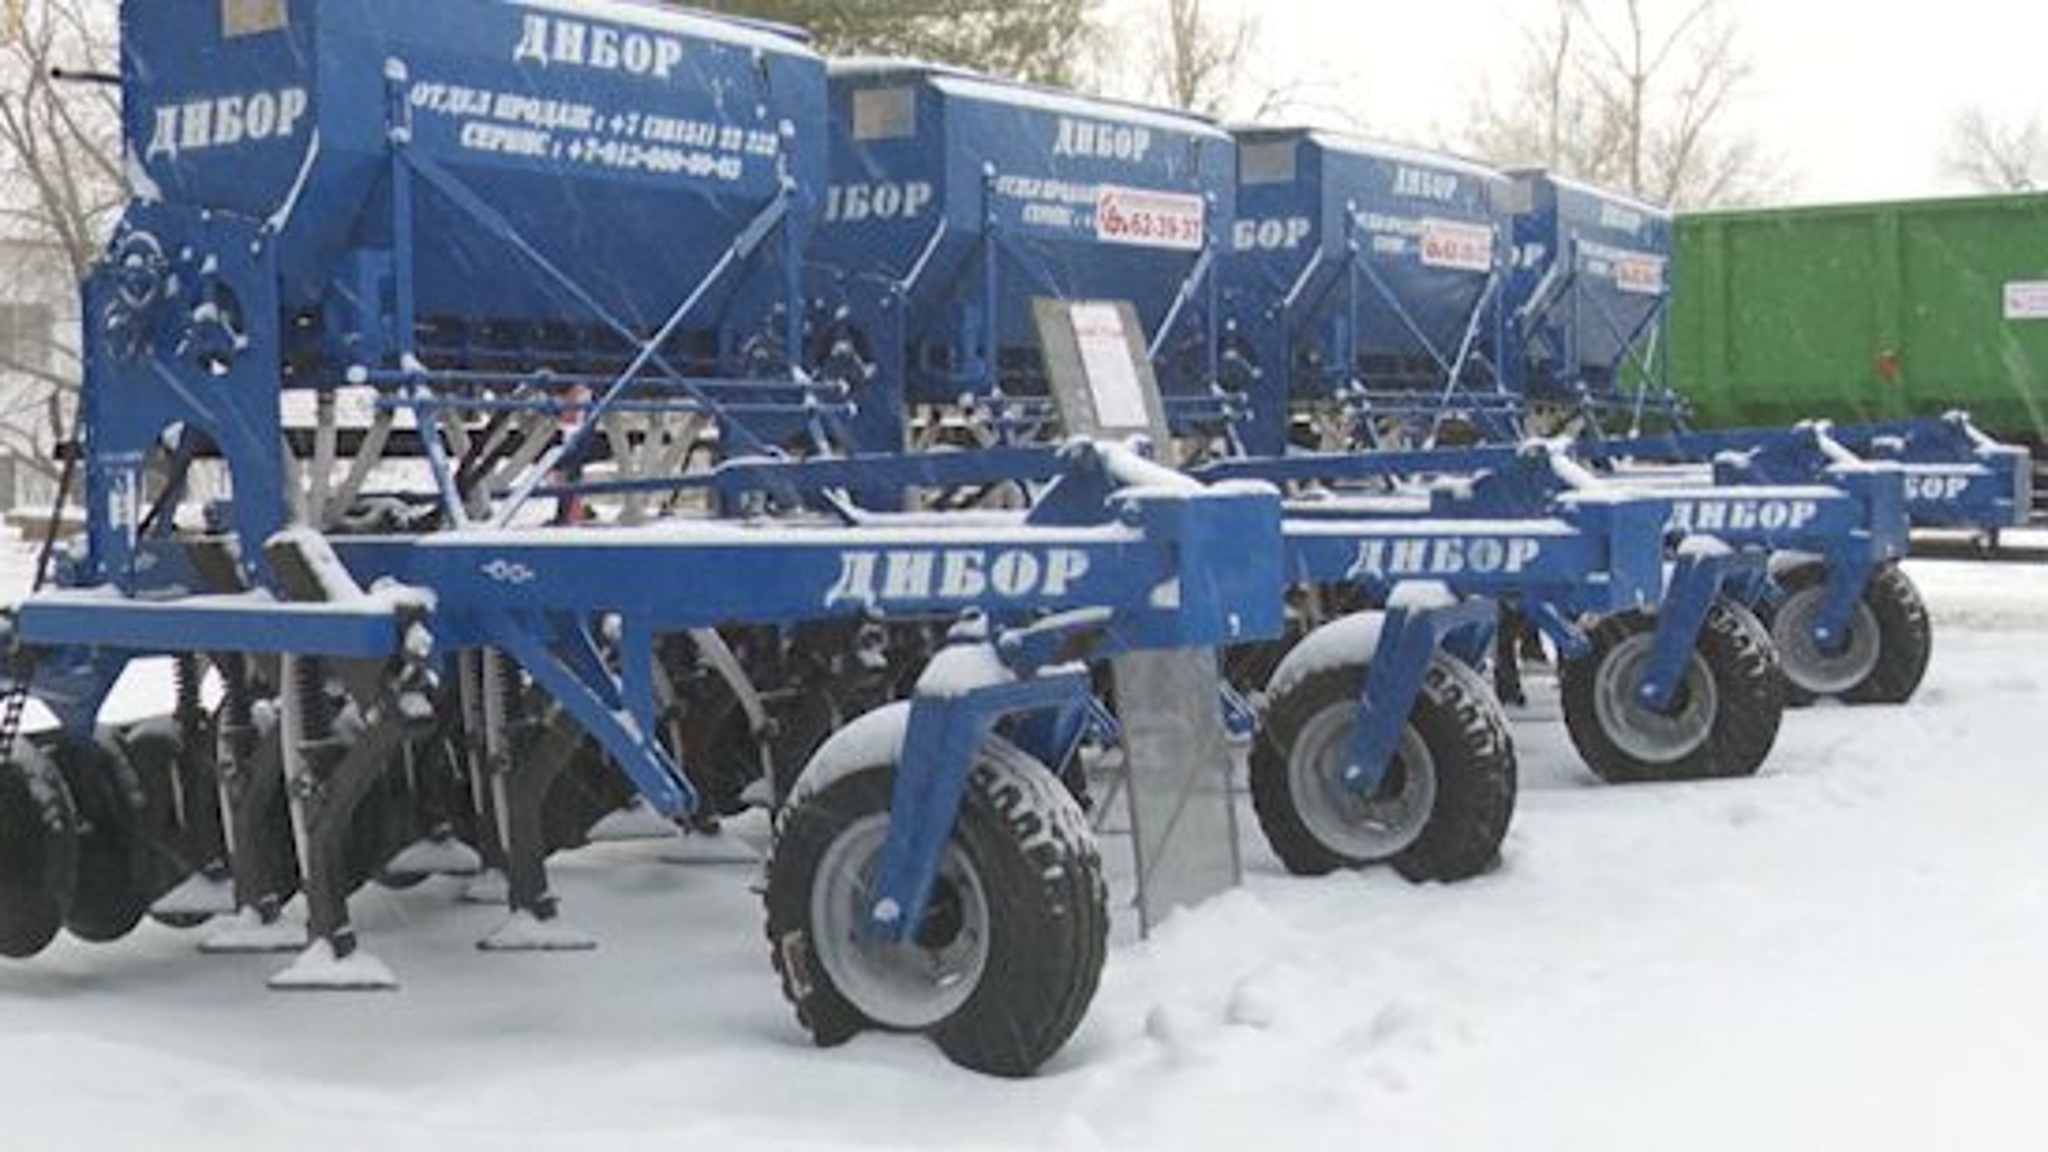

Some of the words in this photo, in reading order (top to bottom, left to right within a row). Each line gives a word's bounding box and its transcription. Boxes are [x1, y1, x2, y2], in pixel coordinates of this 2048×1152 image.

[513, 13, 683, 78] ДИБОР
[411, 82, 491, 117] ОТДЕЛ
[145, 88, 307, 163] ДИБОР
[1052, 119, 1151, 162] ДИБОР
[1662, 499, 1817, 532] ДИБОР
[824, 547, 1091, 608] ДИБОР
[1345, 537, 1542, 580] ДИБОР
